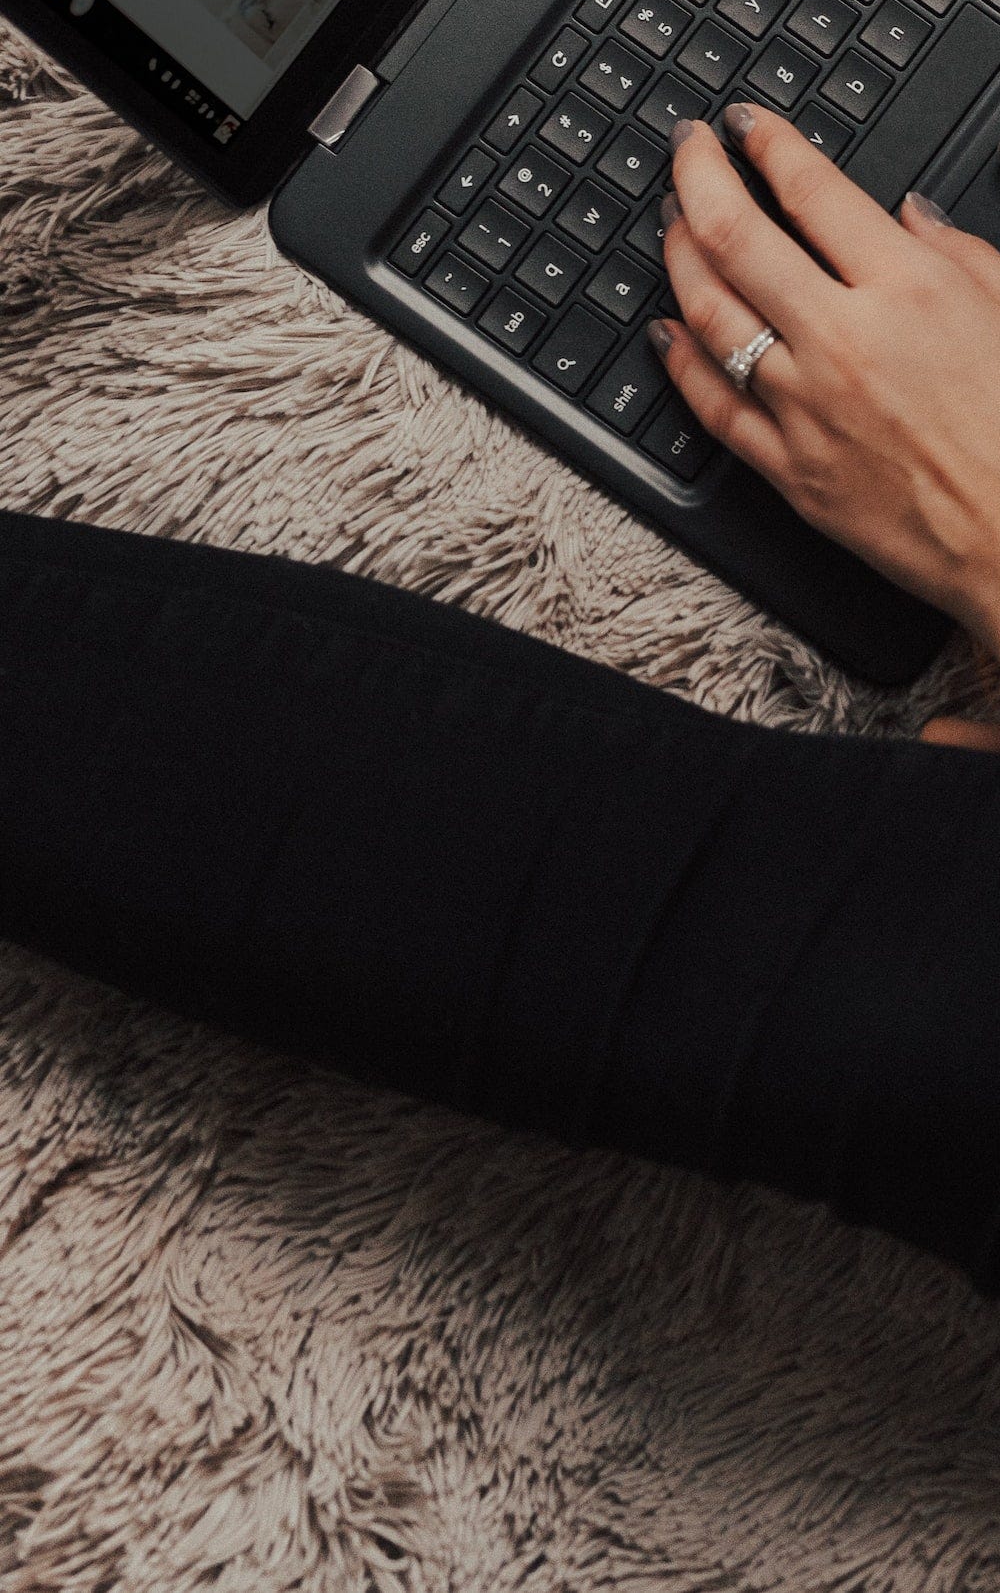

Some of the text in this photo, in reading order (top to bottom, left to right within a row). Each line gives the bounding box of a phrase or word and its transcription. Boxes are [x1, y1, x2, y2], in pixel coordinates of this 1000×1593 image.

[637, 8, 654, 22] %
[811, 14, 831, 28] h
[657, 21, 673, 36] 5
[889, 25, 905, 40] n
[704, 50, 722, 62] t
[599, 61, 612, 74] $
[776, 66, 795, 84] g
[619, 76, 633, 90] 4
[845, 80, 865, 95] b
[665, 103, 678, 116] r
[559, 114, 571, 129] #
[577, 129, 593, 144] 3
[809, 132, 824, 145] v
[626, 156, 640, 169] e
[517, 167, 533, 183] @
[537, 183, 553, 197] 2
[582, 207, 601, 225] w
[411, 231, 431, 254] esc
[497, 237, 512, 248] 1
[544, 262, 564, 277] q
[615, 282, 631, 296] a
[503, 311, 525, 333] tab
[613, 383, 638, 413] shift
[670, 431, 691, 455] ctrl
